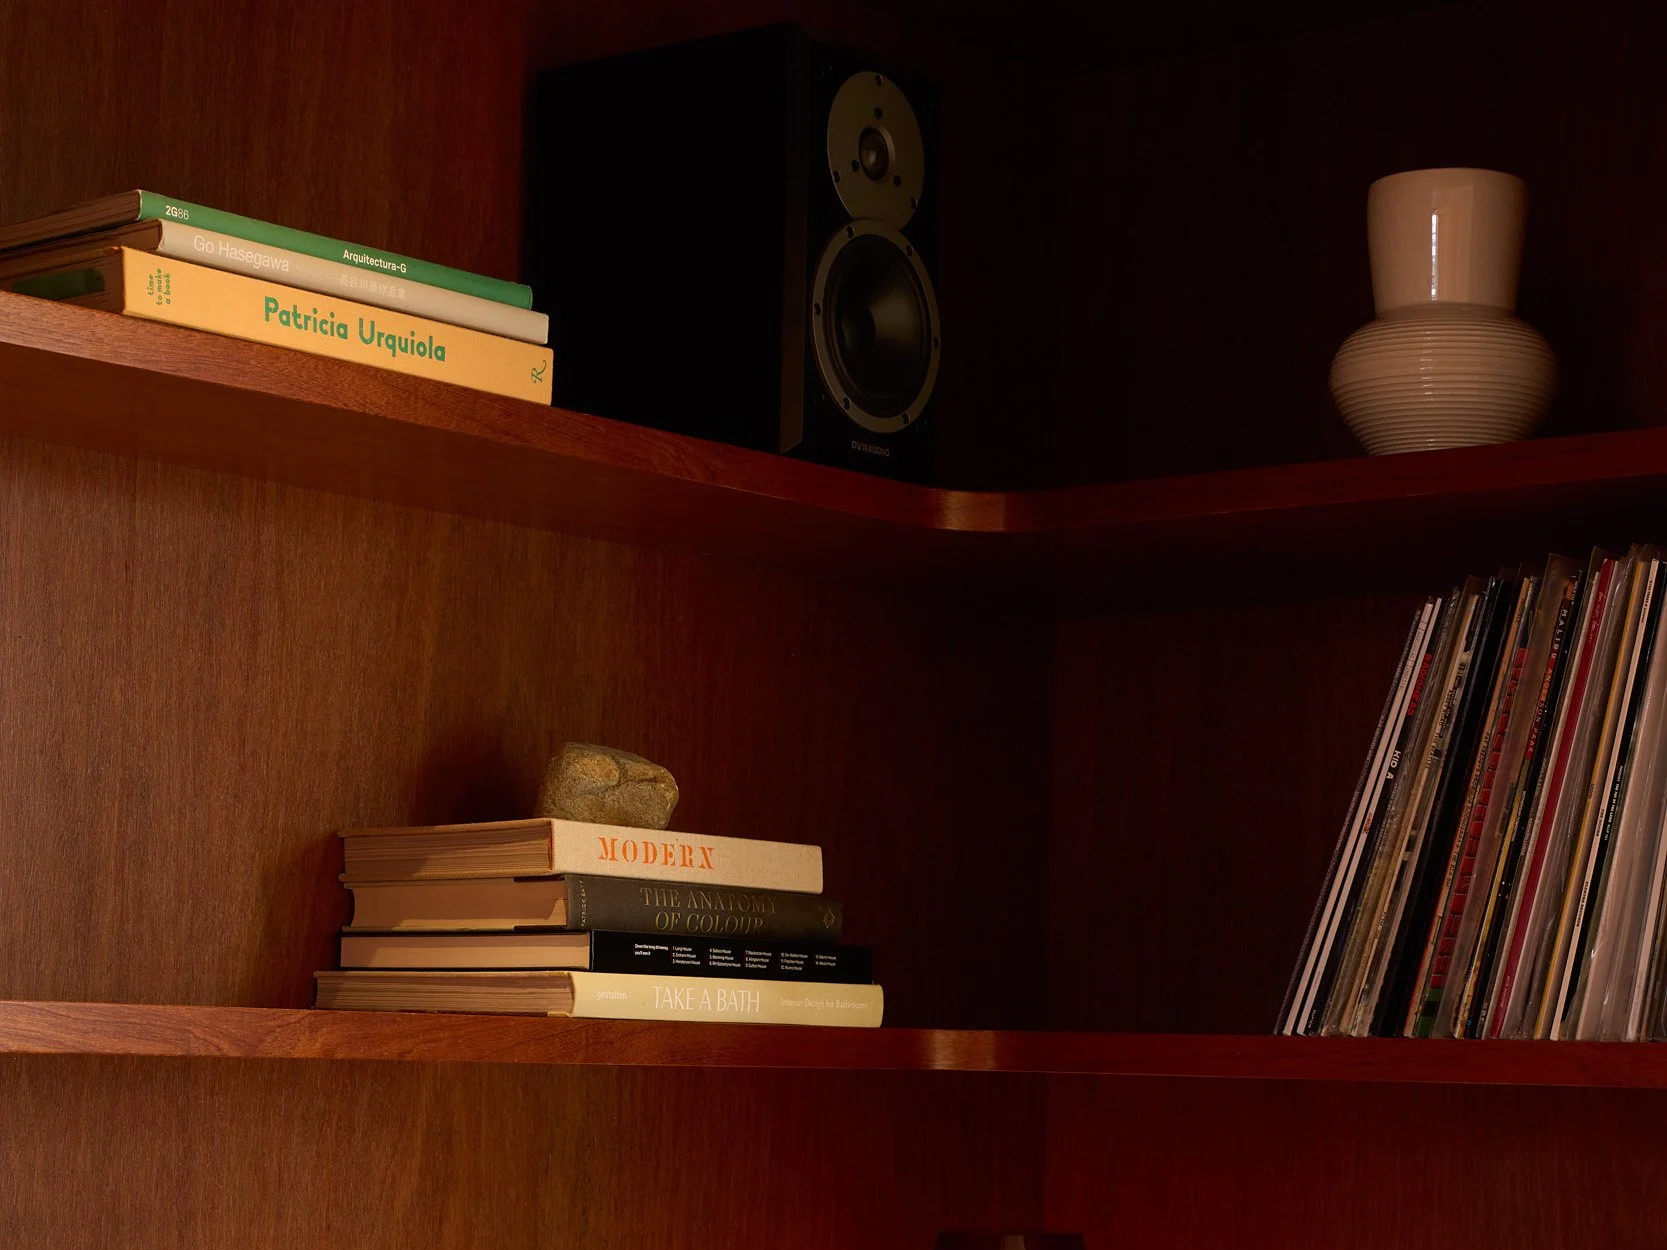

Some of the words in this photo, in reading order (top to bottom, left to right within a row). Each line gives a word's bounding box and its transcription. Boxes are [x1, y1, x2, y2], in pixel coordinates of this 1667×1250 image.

[165, 205, 189, 220] 2G86
[194, 235, 214, 253] Go
[219, 241, 290, 272] Hasegawa
[343, 249, 407, 274] Arquitectura-G
[156, 295, 162, 305] to
[264, 296, 348, 340] Patricia
[358, 317, 446, 362] Urquiola
[1551, 608, 1568, 659] MALIBU
[1407, 652, 1433, 717] RADIOHEAD
[1390, 749, 1401, 768] KID
[1386, 771, 1394, 780] A
[598, 836, 715, 870] MODERN
[640, 887, 681, 908] THE
[687, 890, 777, 914] ANATOMY
[655, 911, 681, 931] OF
[686, 911, 764, 935] COLOUR
[597, 990, 627, 1002] gestalten
[652, 985, 695, 1011] TAKE
[699, 988, 713, 1011] A
[717, 988, 760, 1013] BATH
[804, 998, 825, 1010] Design
[825, 998, 835, 1008] for
